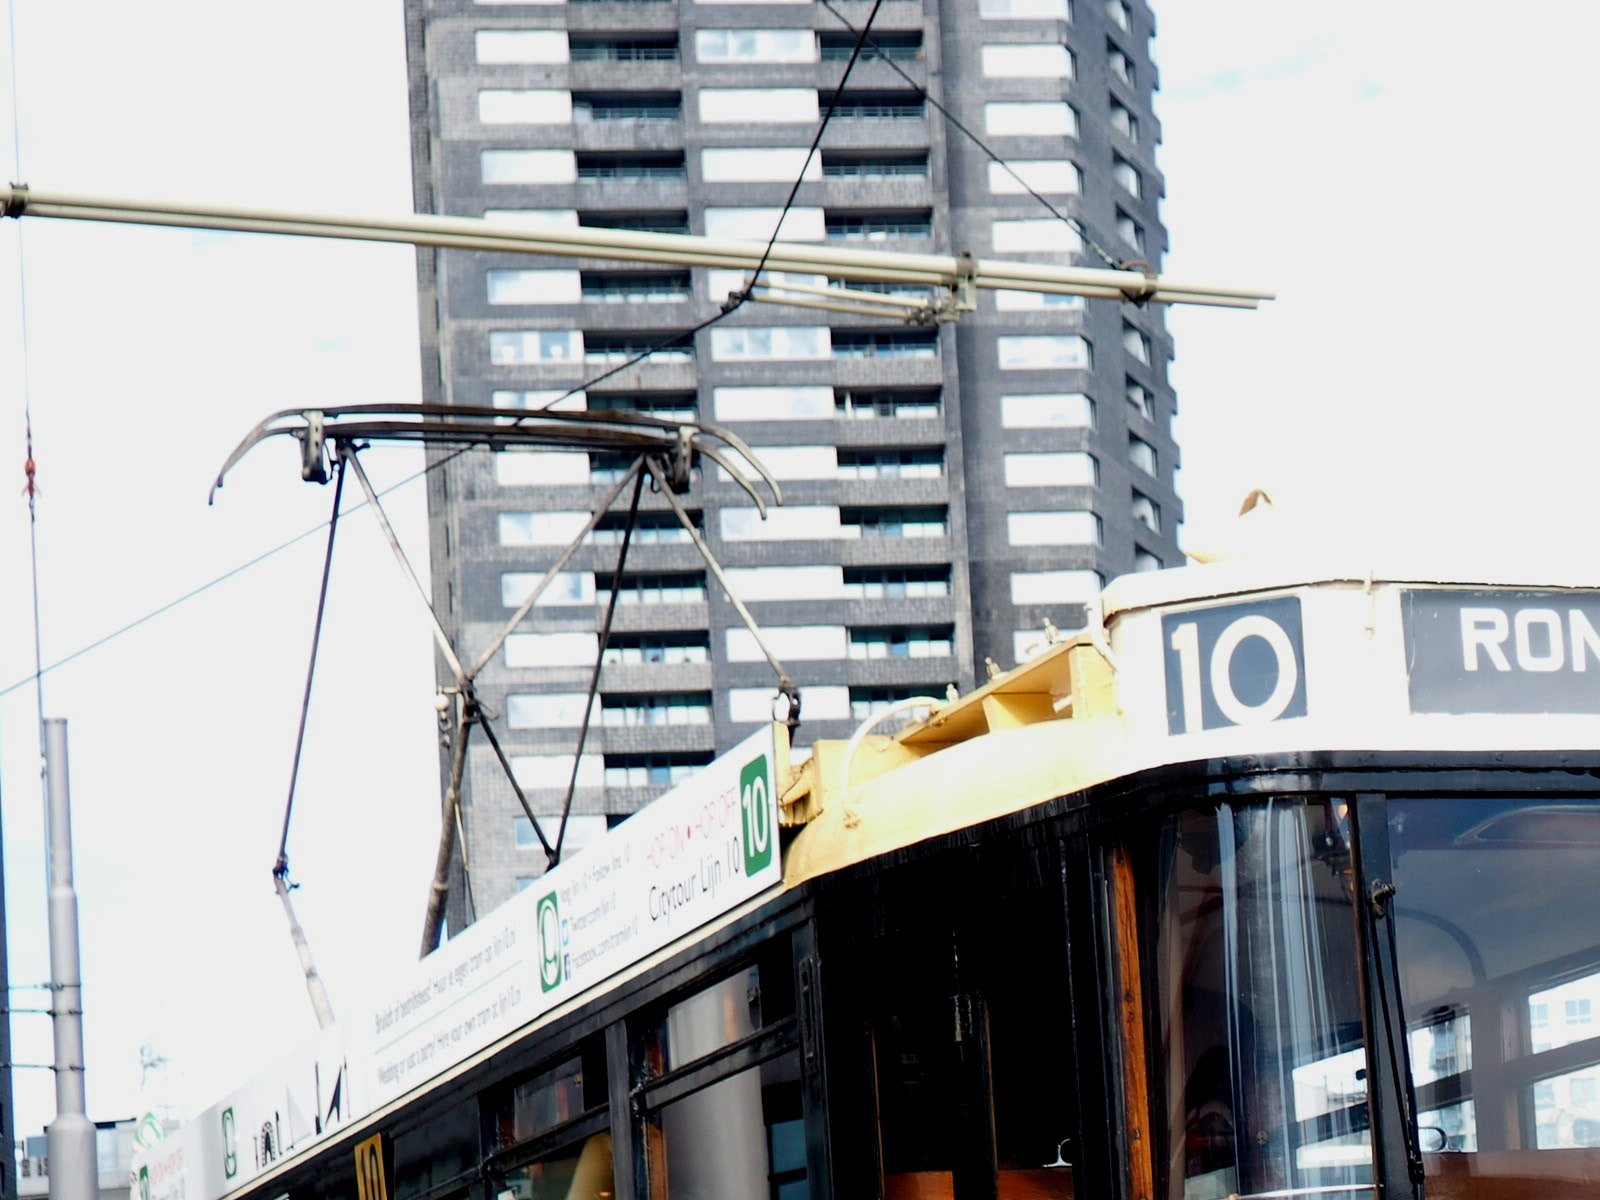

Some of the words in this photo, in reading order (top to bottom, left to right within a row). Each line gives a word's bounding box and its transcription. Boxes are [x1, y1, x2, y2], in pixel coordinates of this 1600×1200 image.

[1170, 614, 1299, 734] 10
[742, 775, 769, 859] 10
[648, 873, 697, 926] Citytour
[700, 852, 723, 900] Lijn
[726, 834, 742, 879] 10
